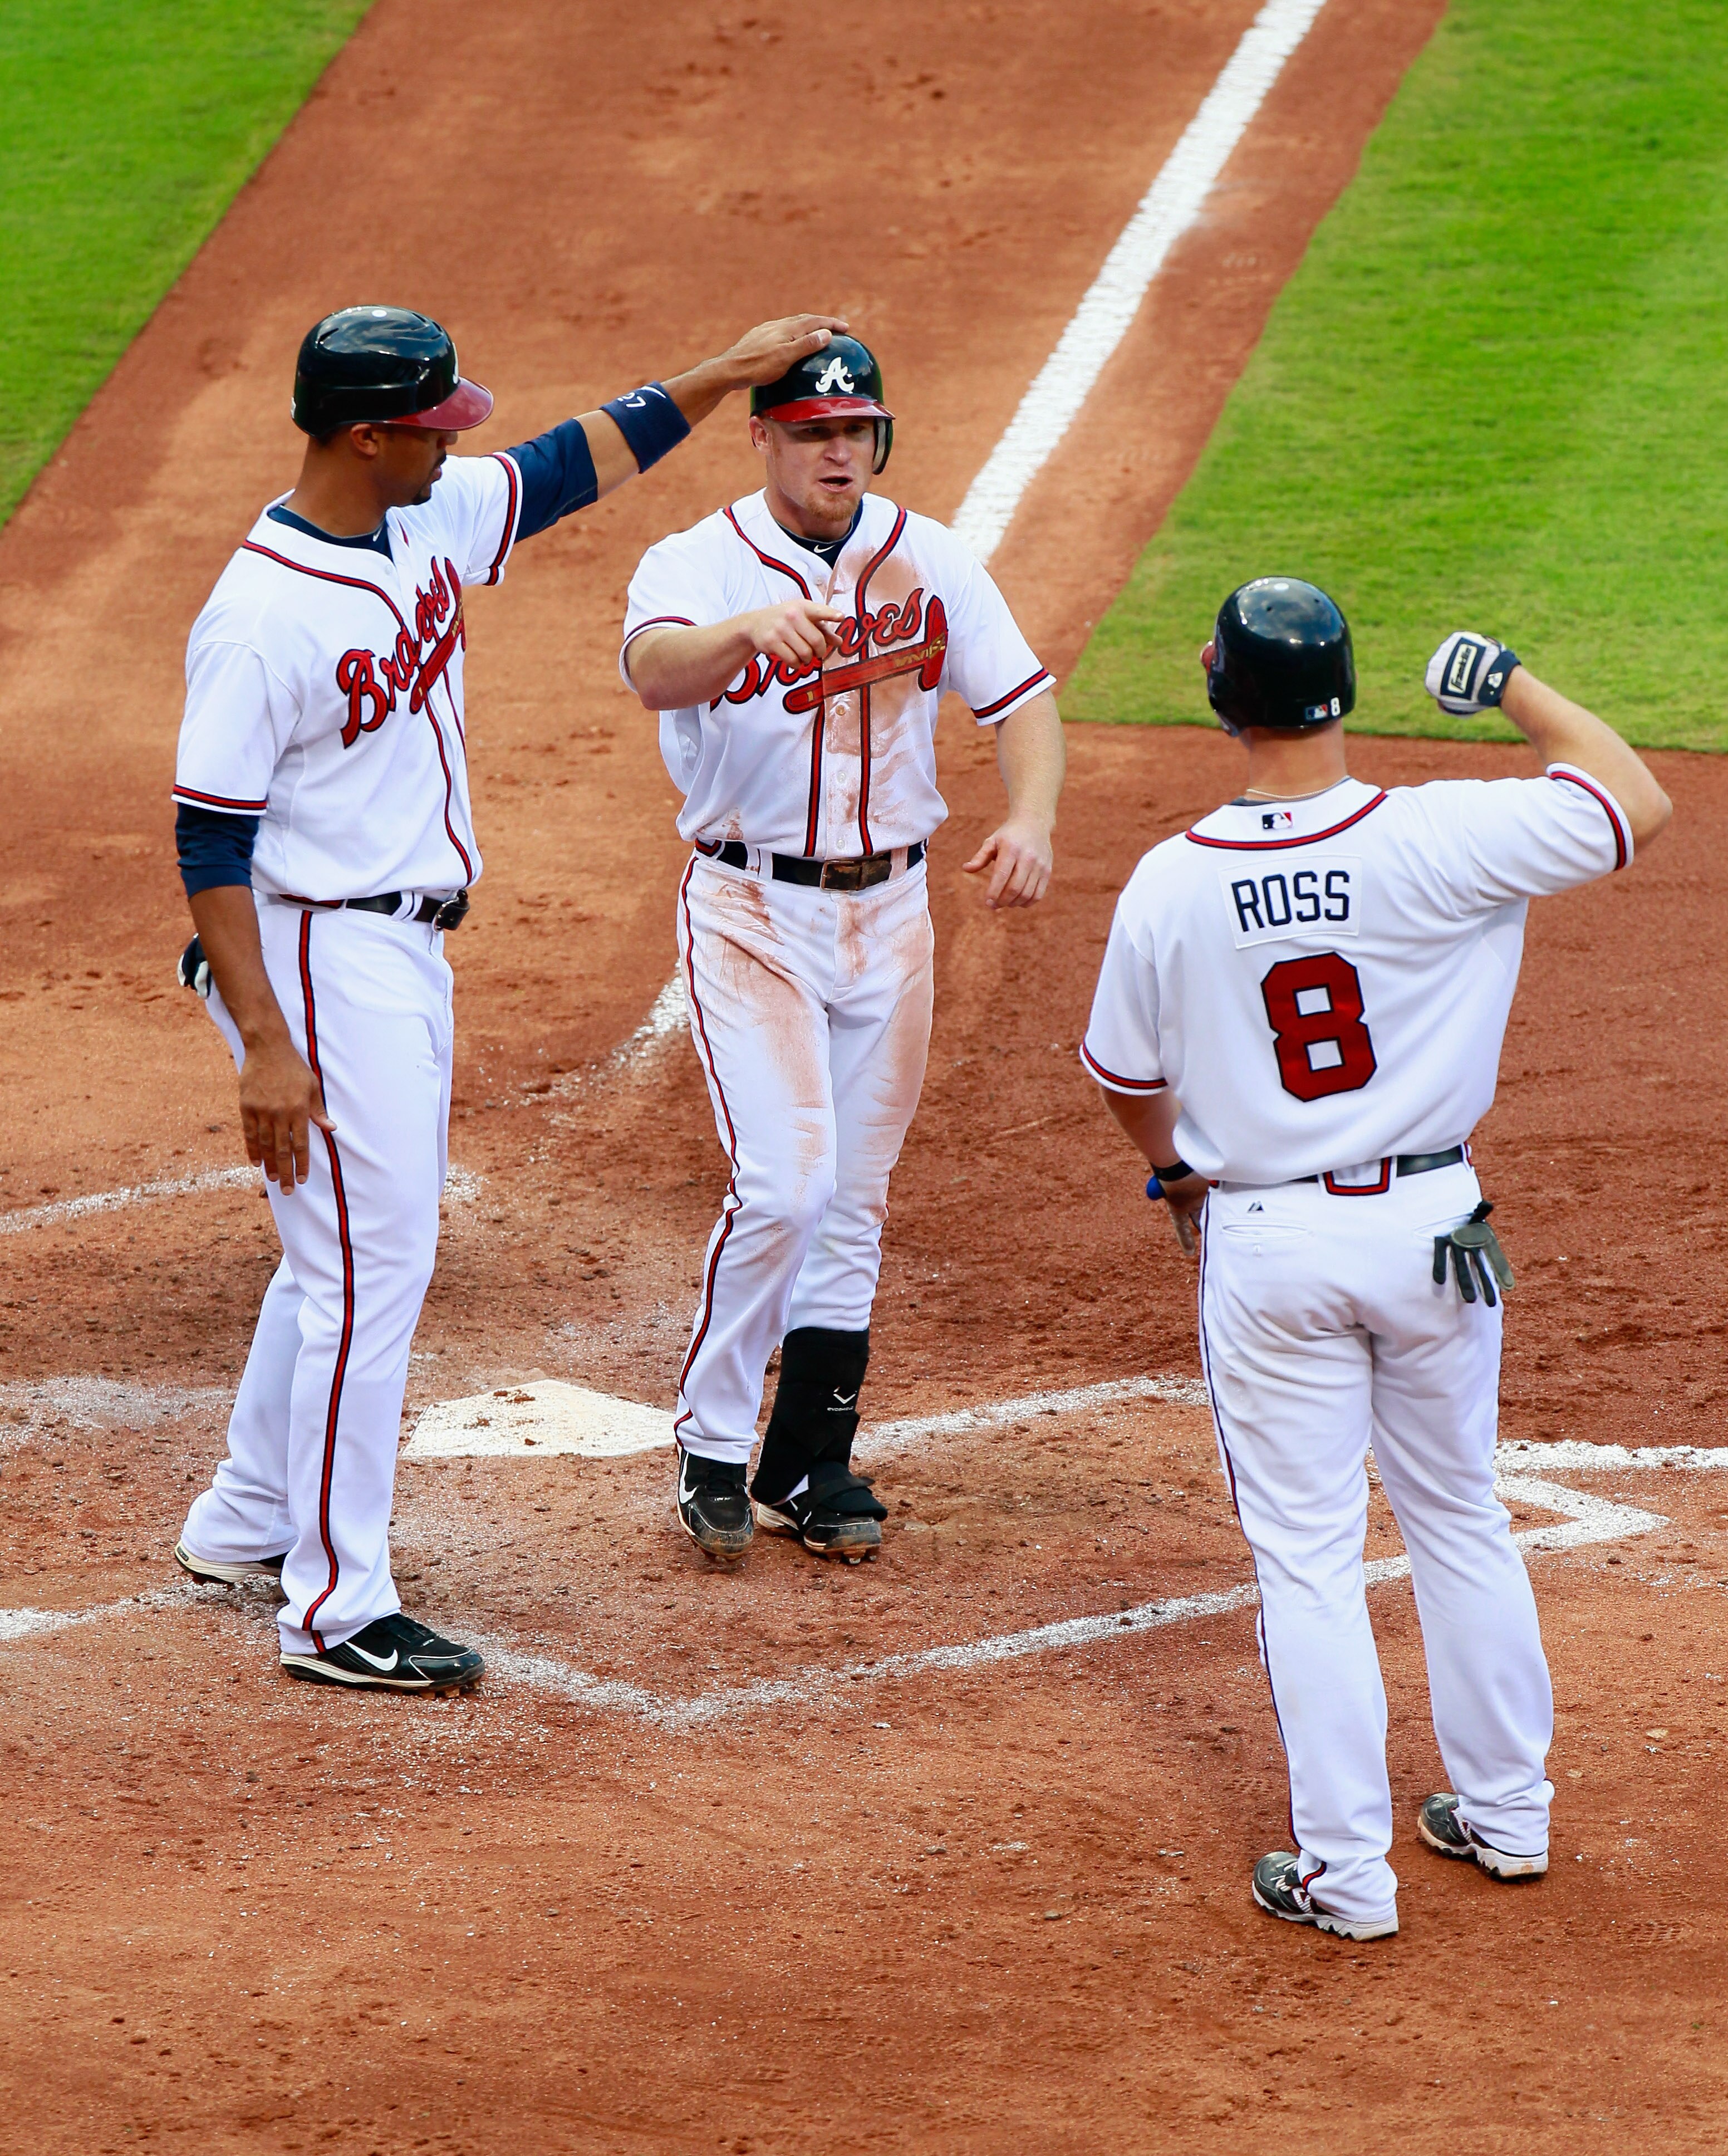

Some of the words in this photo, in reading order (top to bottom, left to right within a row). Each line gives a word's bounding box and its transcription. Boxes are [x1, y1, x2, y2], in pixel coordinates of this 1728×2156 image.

[816, 356, 855, 393] A
[336, 555, 450, 749] Braves
[1330, 697, 1341, 717] 8
[1231, 870, 1350, 932] ROSS
[1260, 950, 1378, 1102] 8
